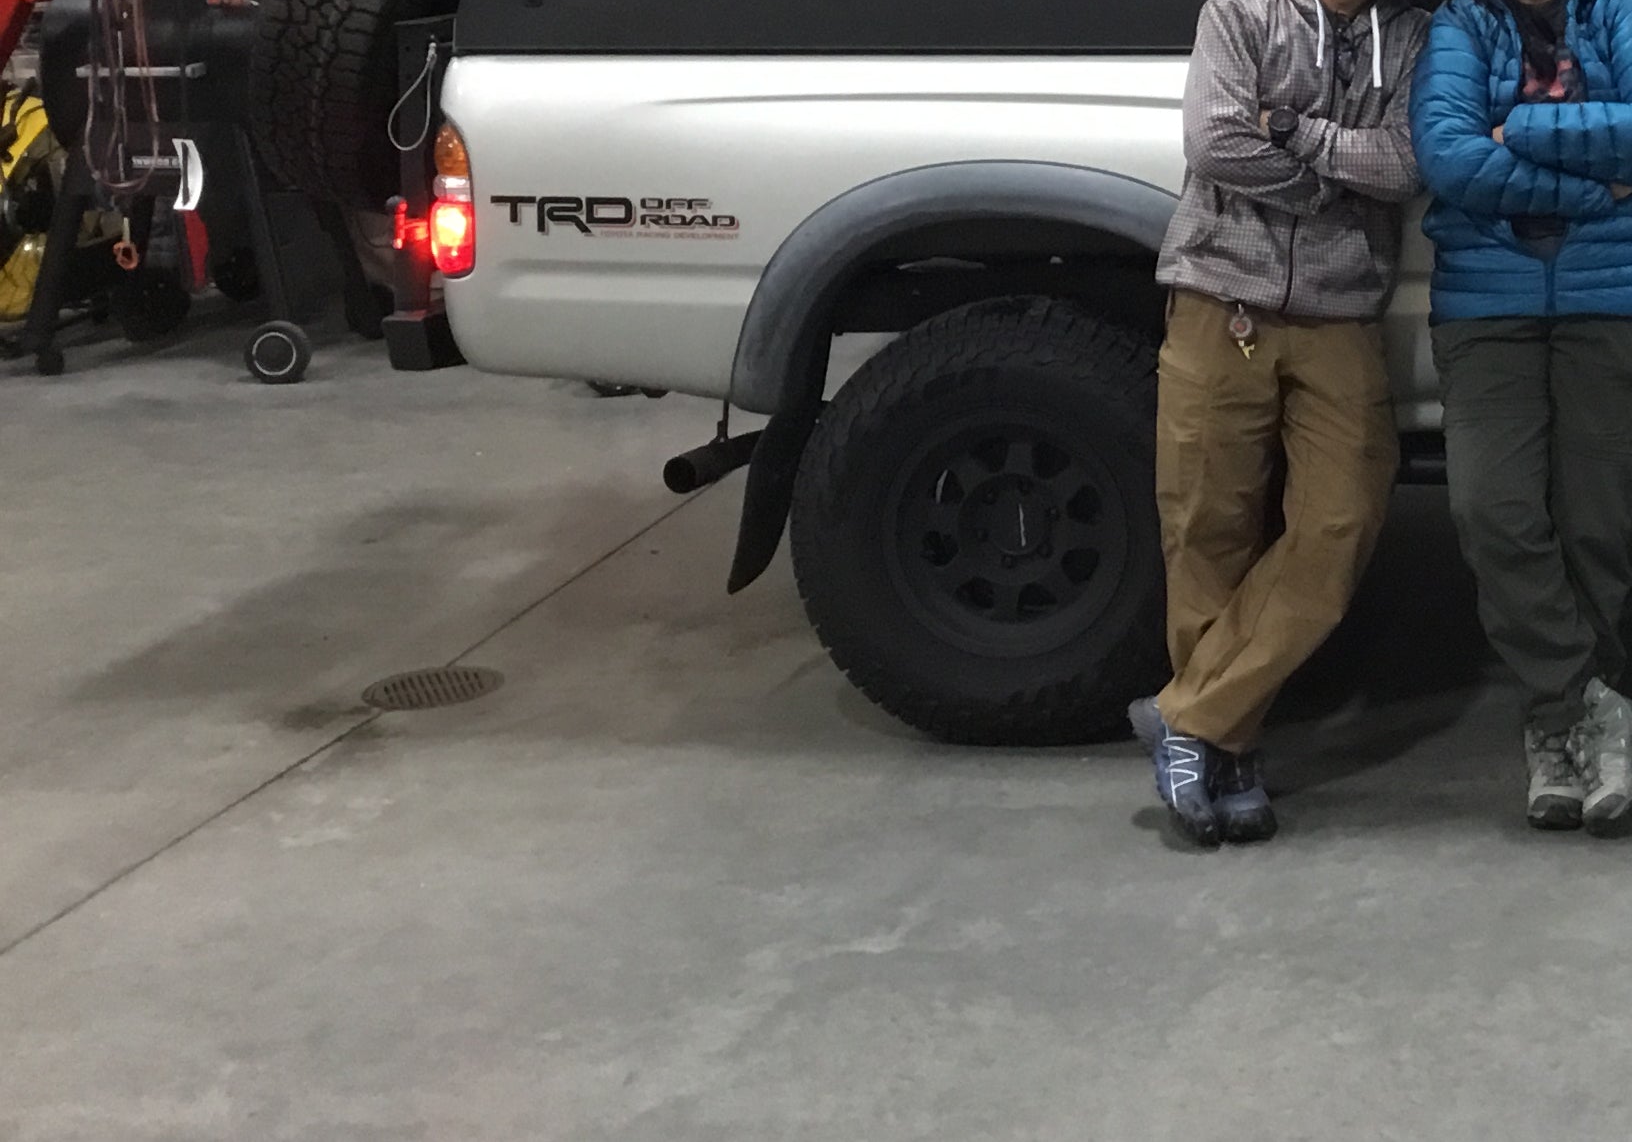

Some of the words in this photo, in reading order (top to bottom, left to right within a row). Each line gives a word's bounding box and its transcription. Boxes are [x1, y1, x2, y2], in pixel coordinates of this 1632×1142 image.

[640, 198, 711, 210] OFF
[491, 195, 636, 235] TRD
[640, 214, 738, 229] ROAD
